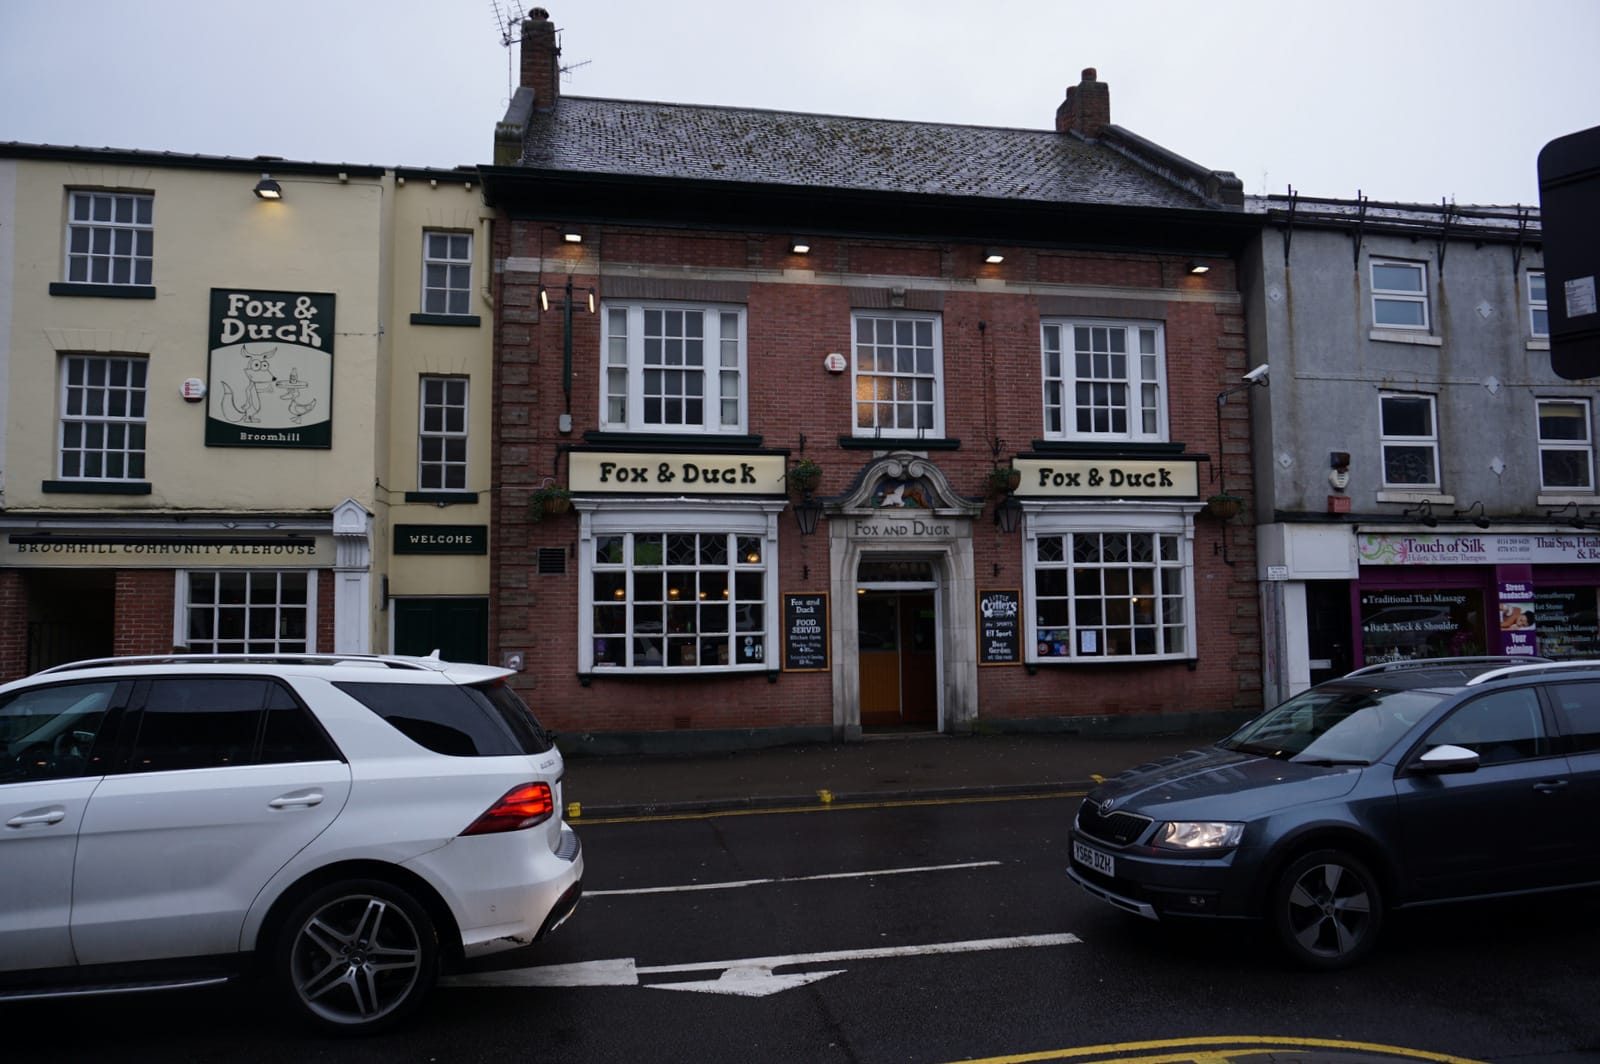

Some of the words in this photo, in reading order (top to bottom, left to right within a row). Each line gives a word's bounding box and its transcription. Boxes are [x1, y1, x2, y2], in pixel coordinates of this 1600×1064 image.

[227, 294, 286, 318] Fox
[294, 296, 318, 319] &
[221, 318, 322, 347] Duck
[240, 432, 300, 442] Broomhill
[600, 462, 648, 483] Fox
[657, 462, 676, 483] &
[682, 463, 756, 484] Duck
[1039, 468, 1080, 487] Fox
[1088, 468, 1104, 487] &
[1110, 468, 1173, 487] Duck
[883, 525, 907, 536] AND
[409, 535, 473, 544] WELCOME
[1404, 538, 1445, 553] Touch
[1447, 538, 1461, 553] of
[1461, 538, 1485, 553] Silk
[1534, 537, 1555, 549] Thai
[1556, 537, 1576, 551] Spa,
[17, 543, 117, 554] BROOMHILL
[123, 543, 224, 554] COMMUNITY
[229, 543, 317, 555] ALEHOUSE
[1577, 548, 1587, 560] &
[1367, 593, 1413, 604] Traditional
[1415, 594, 1433, 603] Thai
[1433, 593, 1467, 606] Massage
[796, 618, 817, 627] FOOD
[1370, 623, 1392, 632] Back,
[1393, 621, 1414, 631] Neck
[1414, 622, 1422, 631] &
[1424, 620, 1459, 631] Shoulder
[791, 626, 822, 635] SERVED
[1076, 844, 1093, 865] YS66
[1094, 851, 1111, 873] DZH
